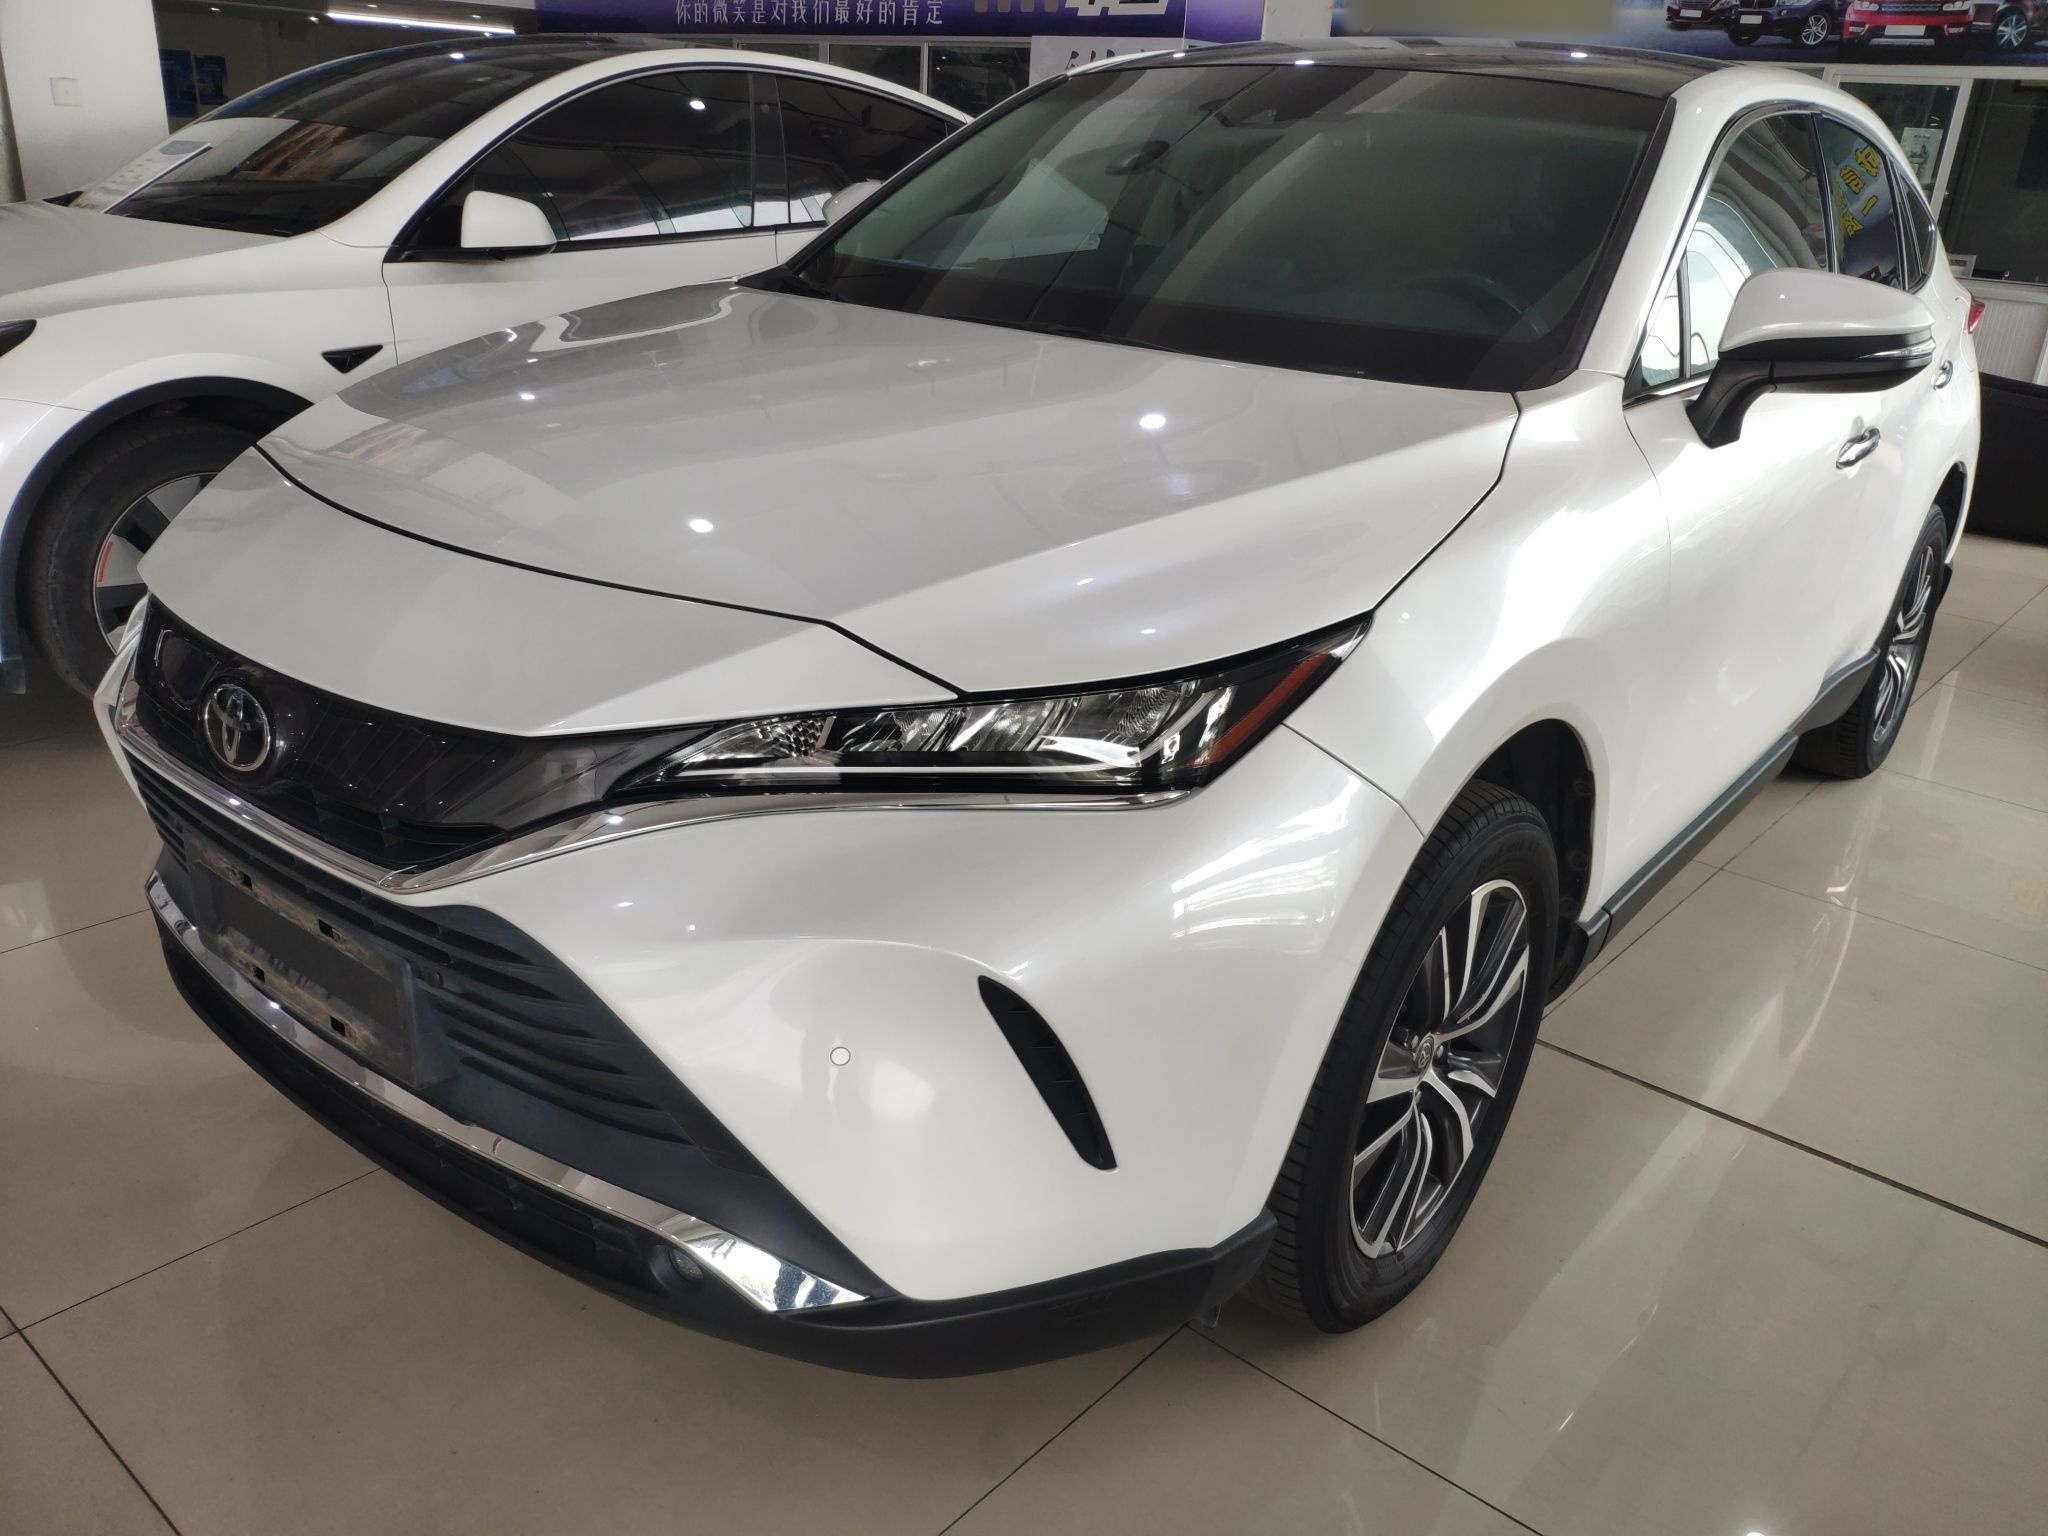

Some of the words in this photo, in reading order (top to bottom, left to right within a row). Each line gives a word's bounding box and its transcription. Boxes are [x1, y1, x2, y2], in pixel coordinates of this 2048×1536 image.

[674, 0, 943, 25] 你的微笑是对我们最好的肯定
